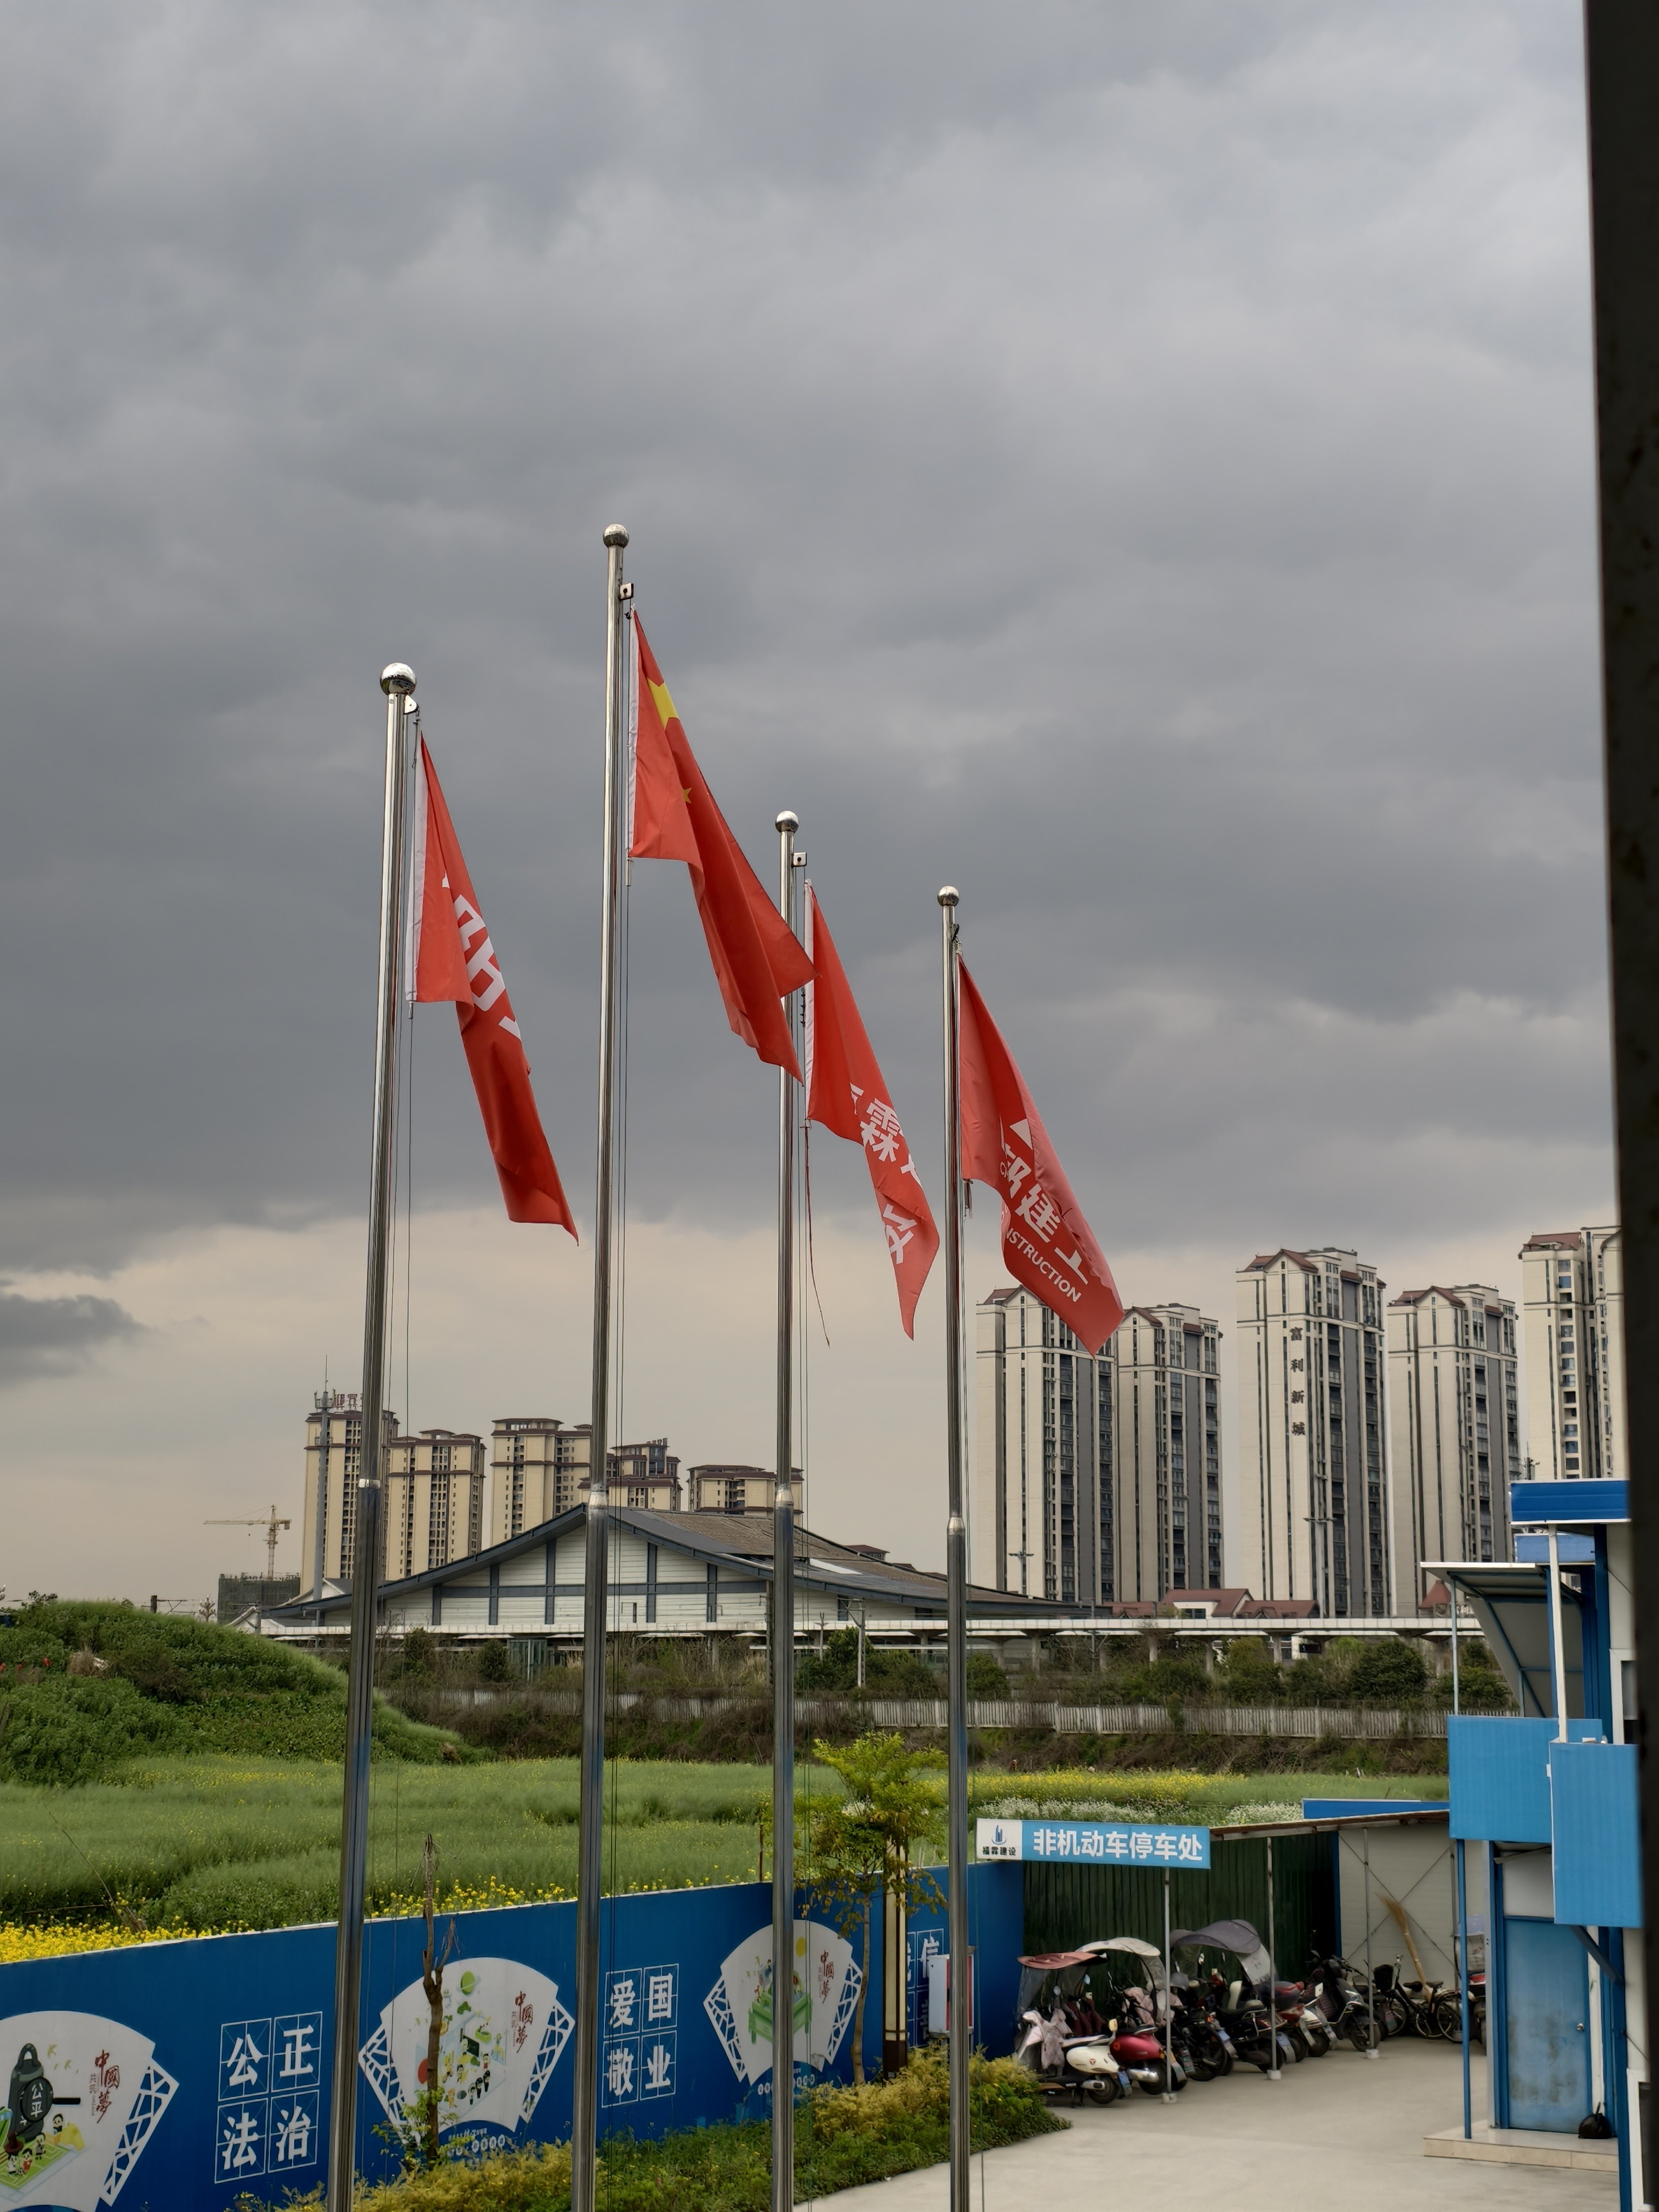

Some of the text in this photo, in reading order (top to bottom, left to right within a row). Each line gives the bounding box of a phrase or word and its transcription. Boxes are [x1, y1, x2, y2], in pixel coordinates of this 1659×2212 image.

[1290, 1327, 1305, 1436] 富利新城
[1033, 1828, 1203, 1861] 非机动车停车处
[609, 1973, 673, 2027] 爱国
[227, 2025, 314, 2087] 公正
[608, 2045, 671, 2096] 敬业
[222, 2106, 312, 2170] 法治
